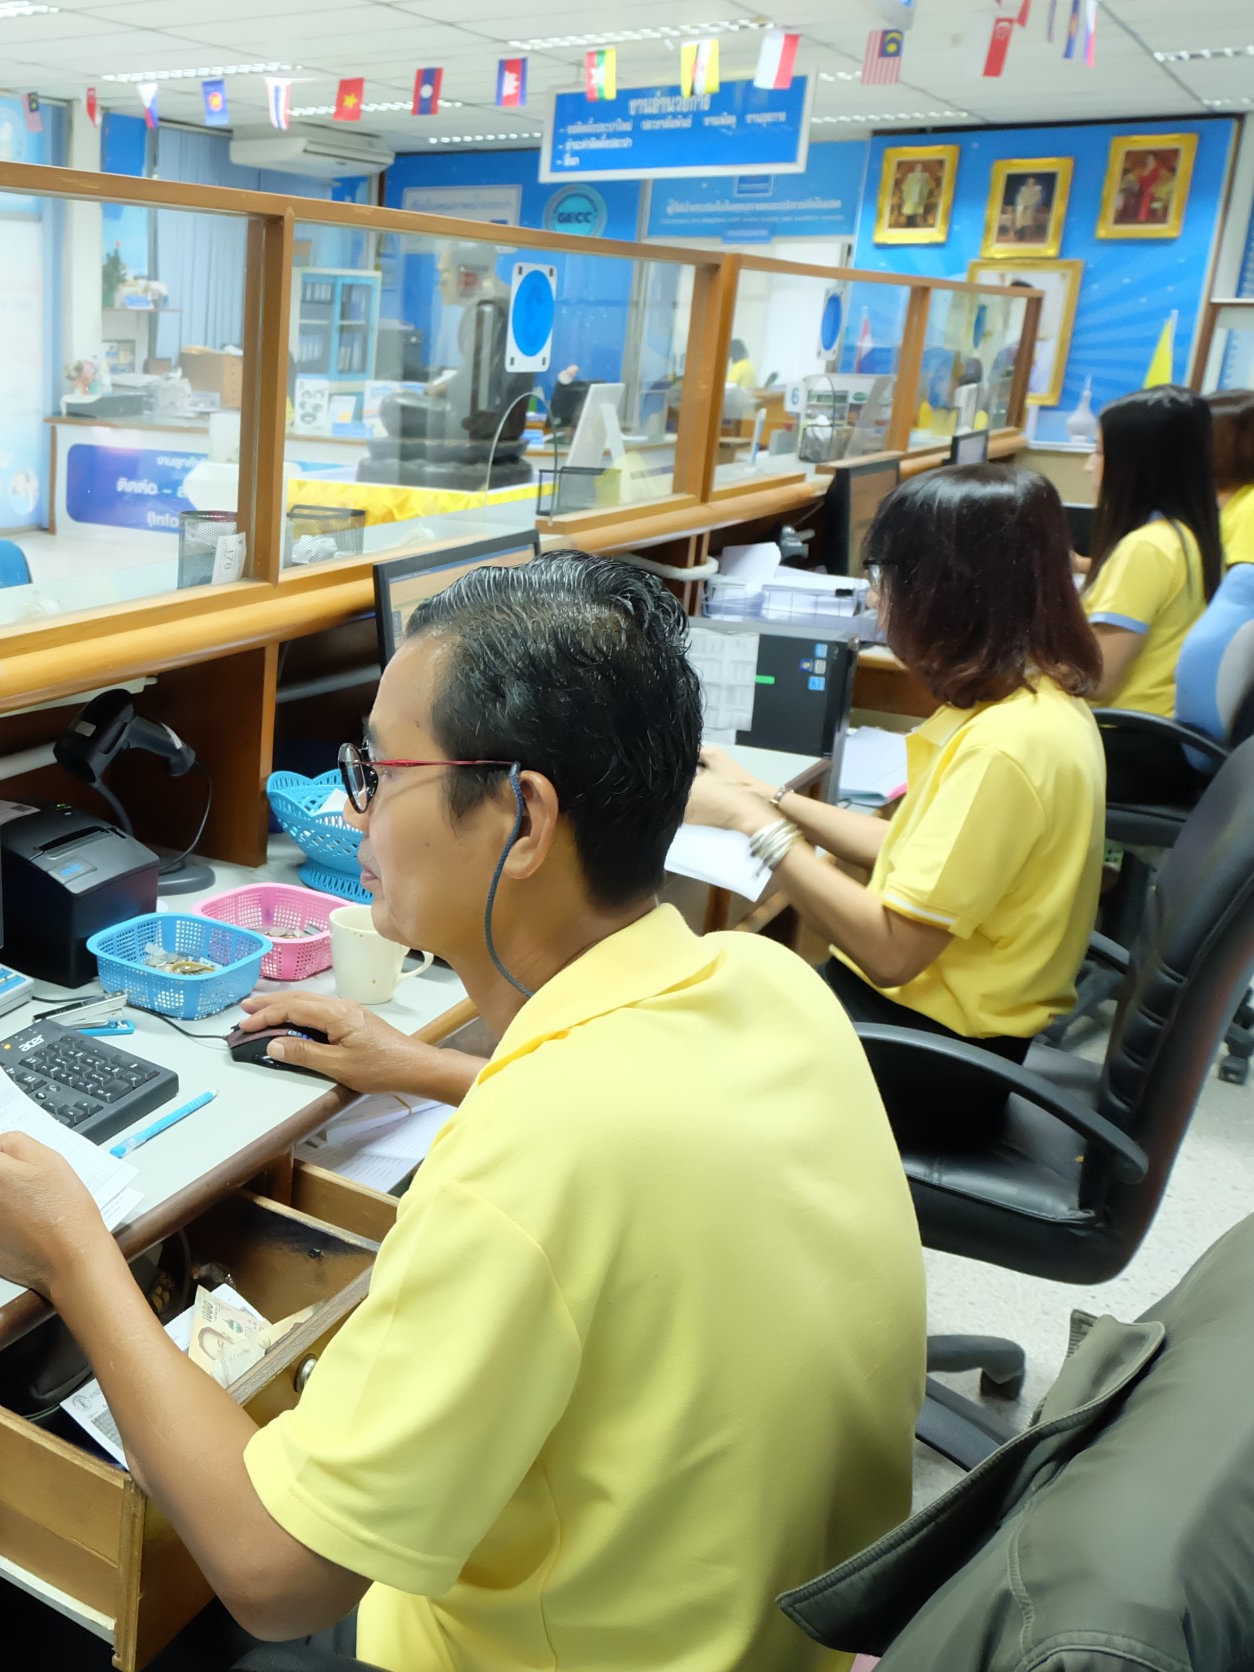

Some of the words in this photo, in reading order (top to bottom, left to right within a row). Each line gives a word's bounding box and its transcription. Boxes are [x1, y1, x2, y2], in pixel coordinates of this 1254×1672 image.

[557, 210, 593, 225] GECC
[791, 387, 800, 406] 6
[117, 477, 158, 495] ติดต่อ
[19, 1035, 45, 1052] acer
